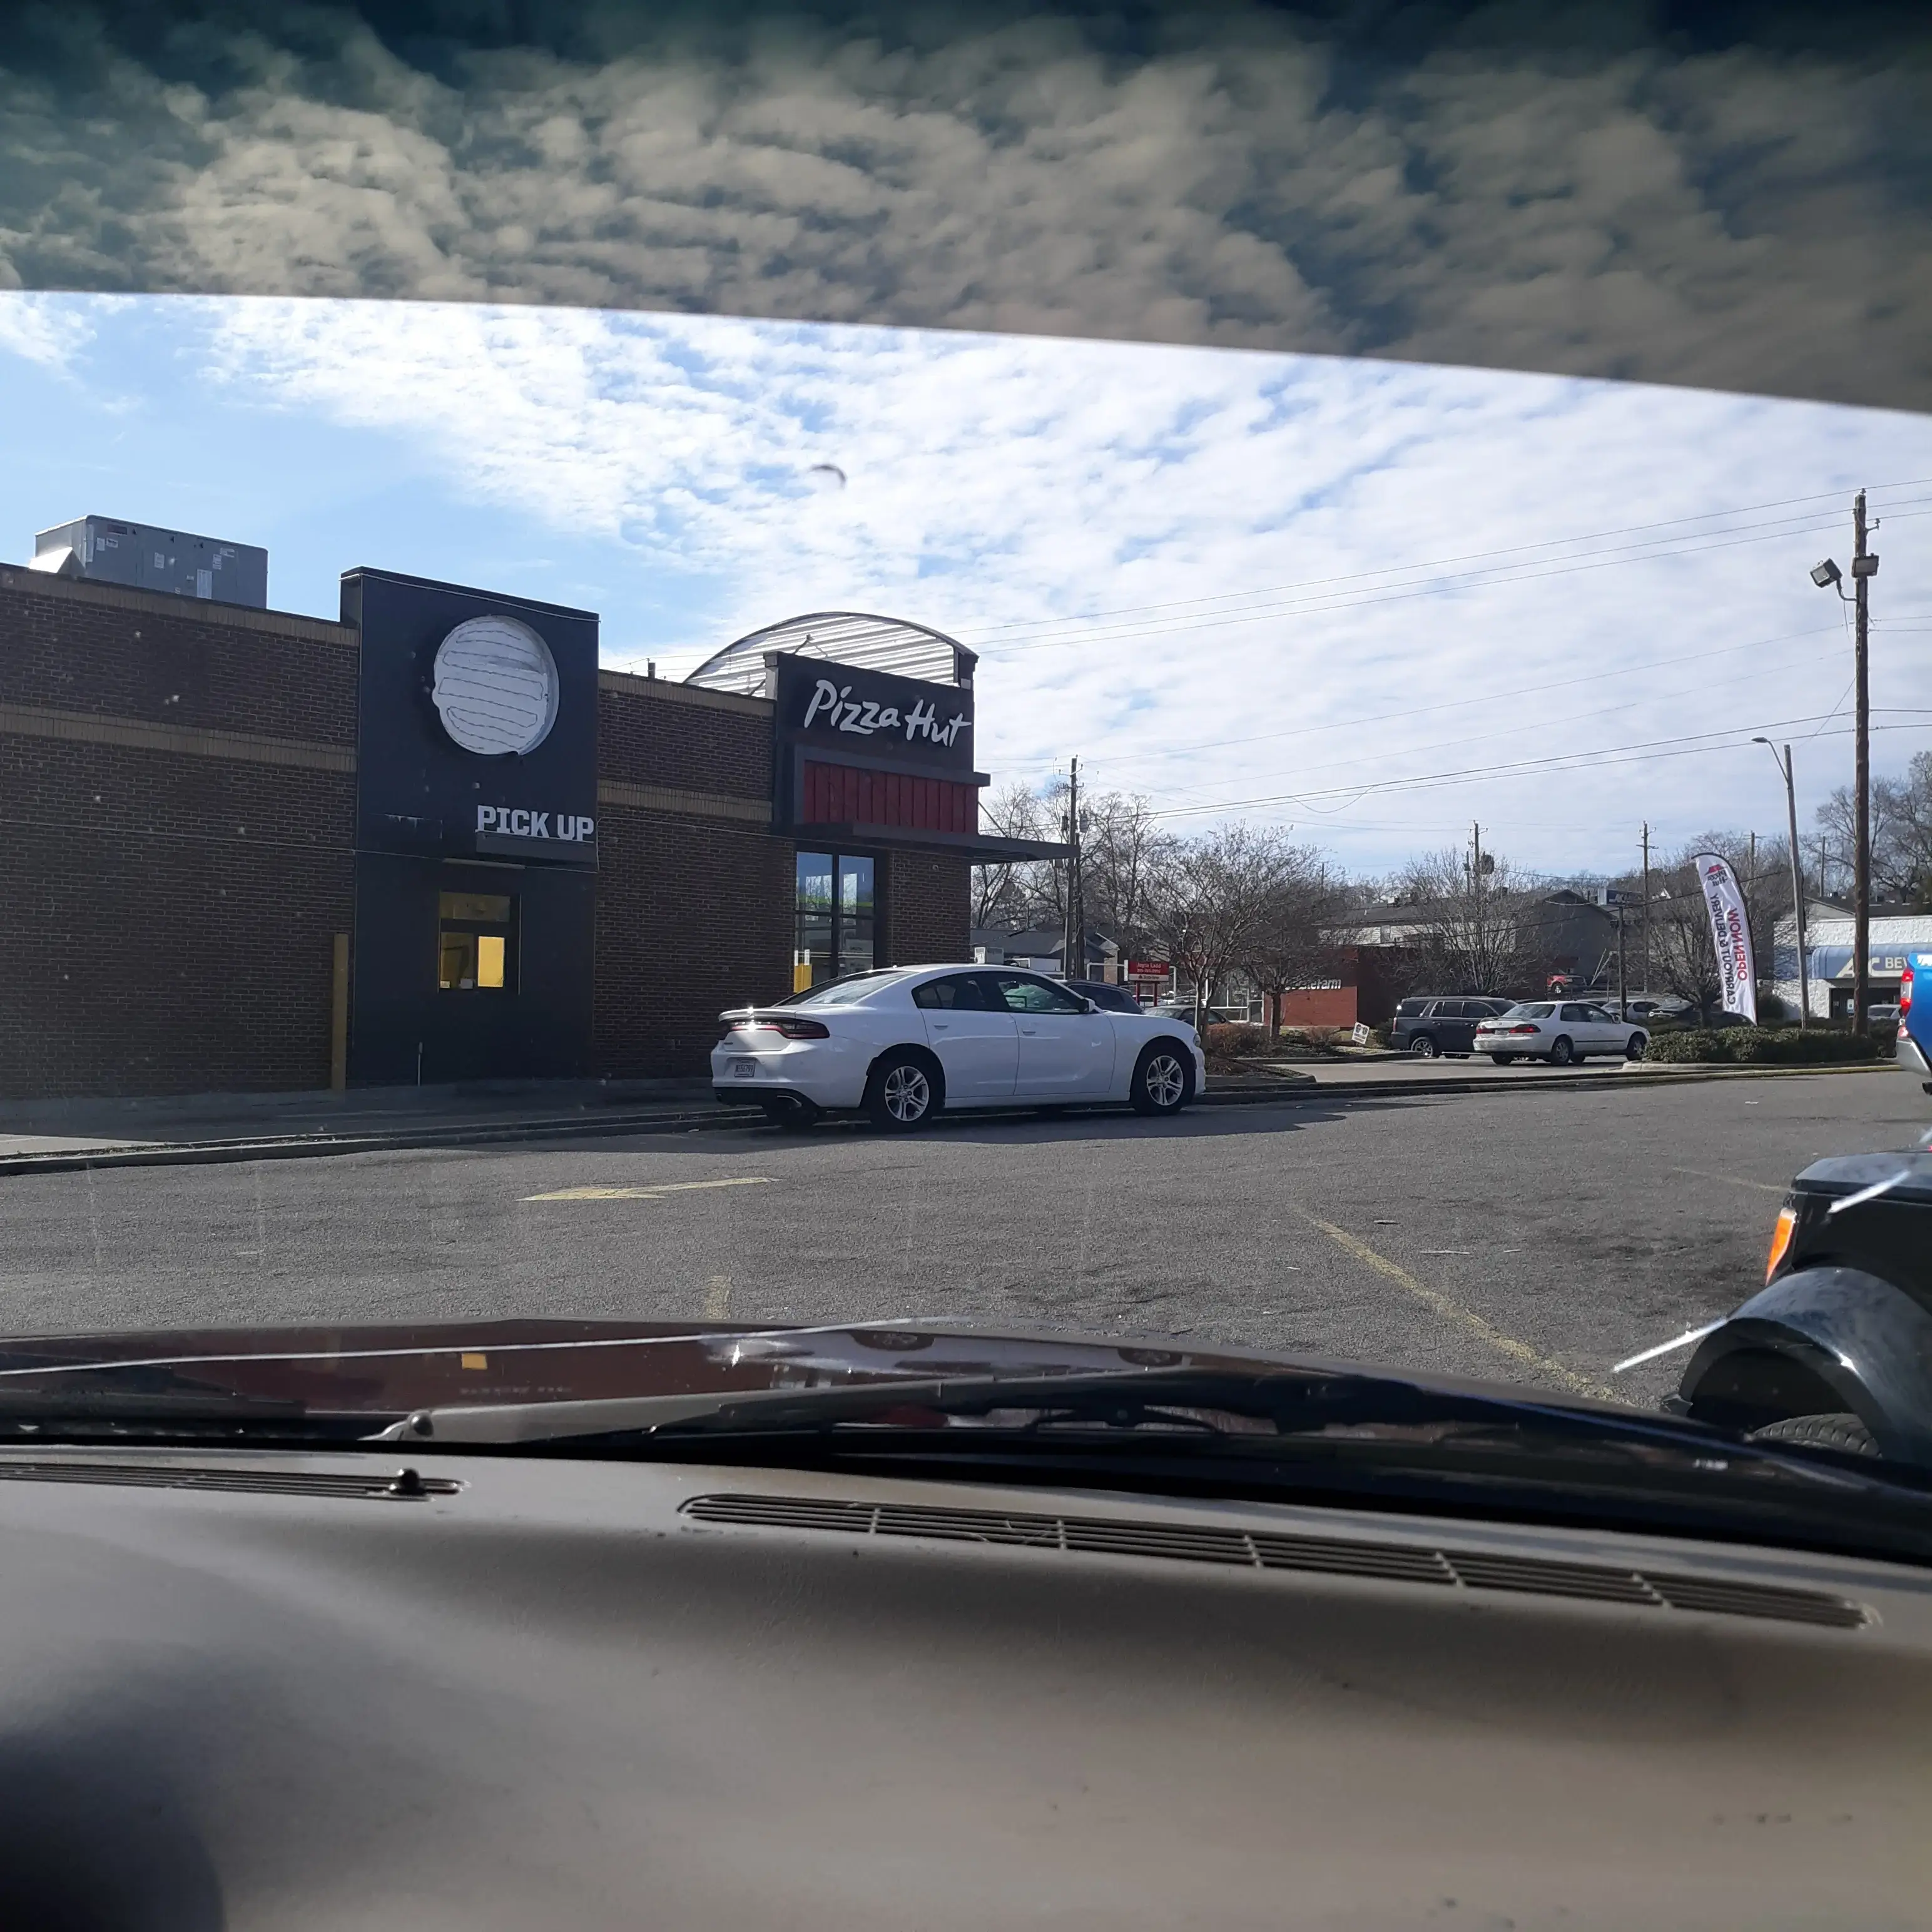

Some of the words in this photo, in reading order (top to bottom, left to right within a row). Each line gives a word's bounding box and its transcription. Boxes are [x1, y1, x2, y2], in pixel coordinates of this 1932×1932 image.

[804, 679, 901, 735] Pizza
[905, 699, 972, 747] Hut
[477, 805, 550, 838] PICK
[557, 814, 594, 841] UP
